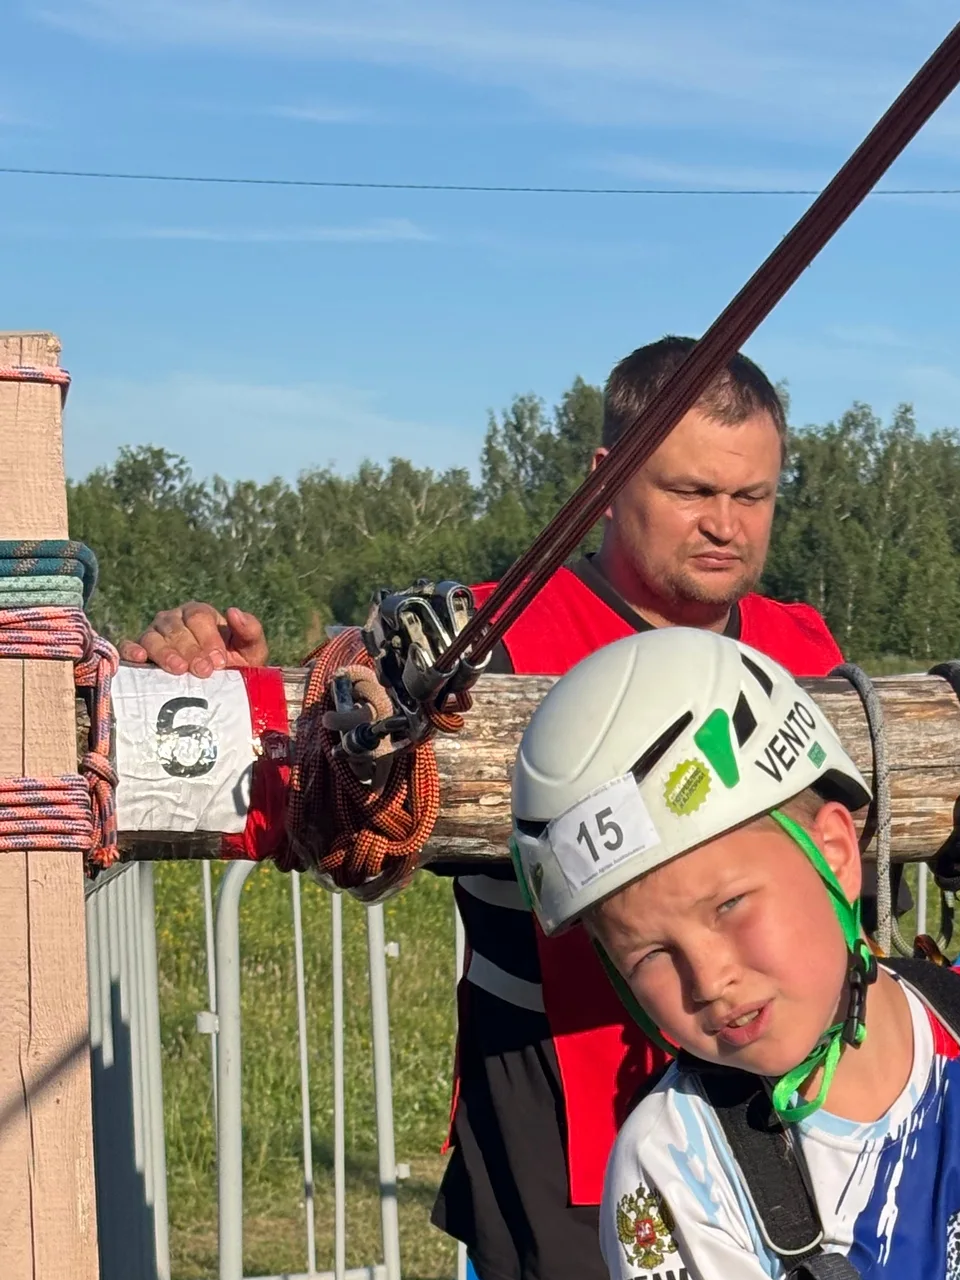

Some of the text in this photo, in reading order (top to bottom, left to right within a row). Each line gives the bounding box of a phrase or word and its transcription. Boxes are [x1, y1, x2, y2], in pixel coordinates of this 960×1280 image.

[157, 696, 217, 778] 6
[755, 701, 816, 783] VENTO
[577, 806, 624, 862] 15
